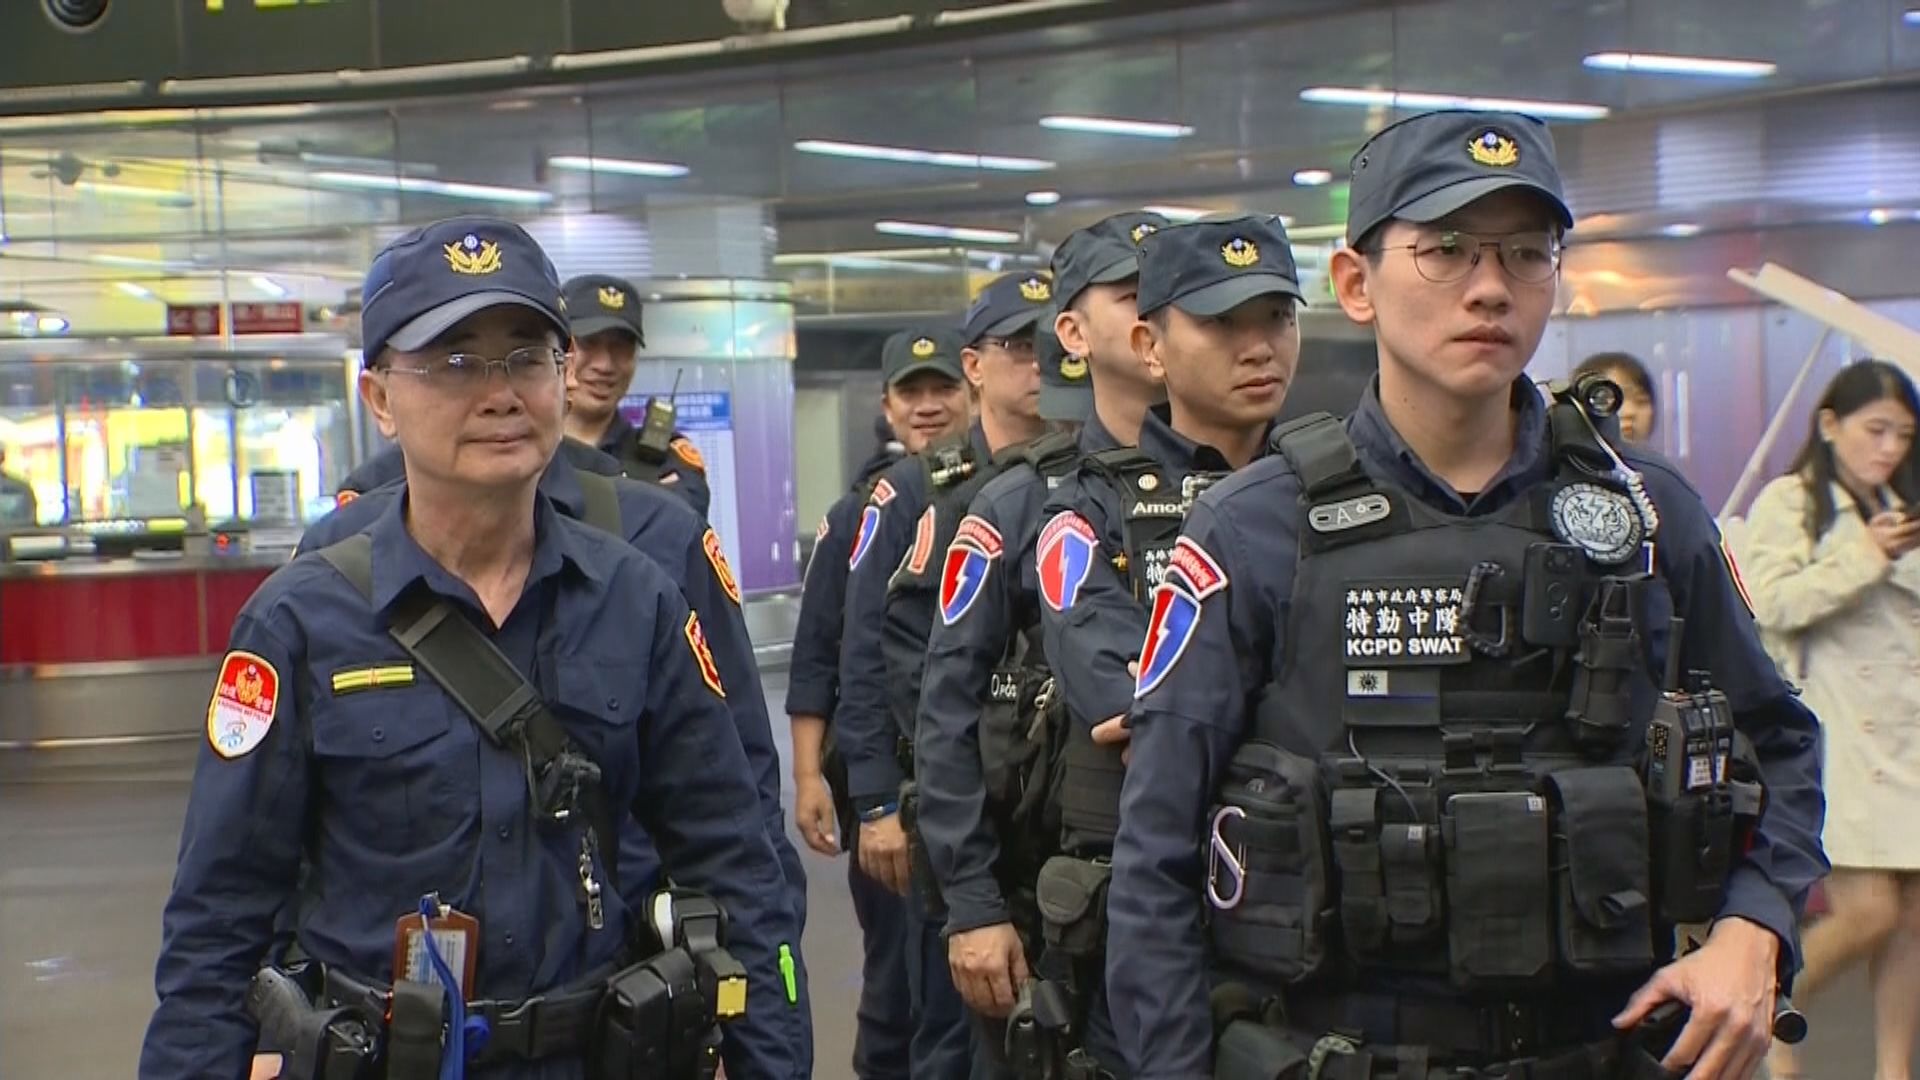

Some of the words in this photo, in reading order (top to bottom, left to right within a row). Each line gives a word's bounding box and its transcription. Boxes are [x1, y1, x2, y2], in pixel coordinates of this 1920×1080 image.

[1346, 588, 1462, 605] 高雄市政府警察局
[1346, 605, 1460, 635] 特勤中隊
[1347, 637, 1402, 656] KCPD
[1408, 637, 1463, 656] SWAT
